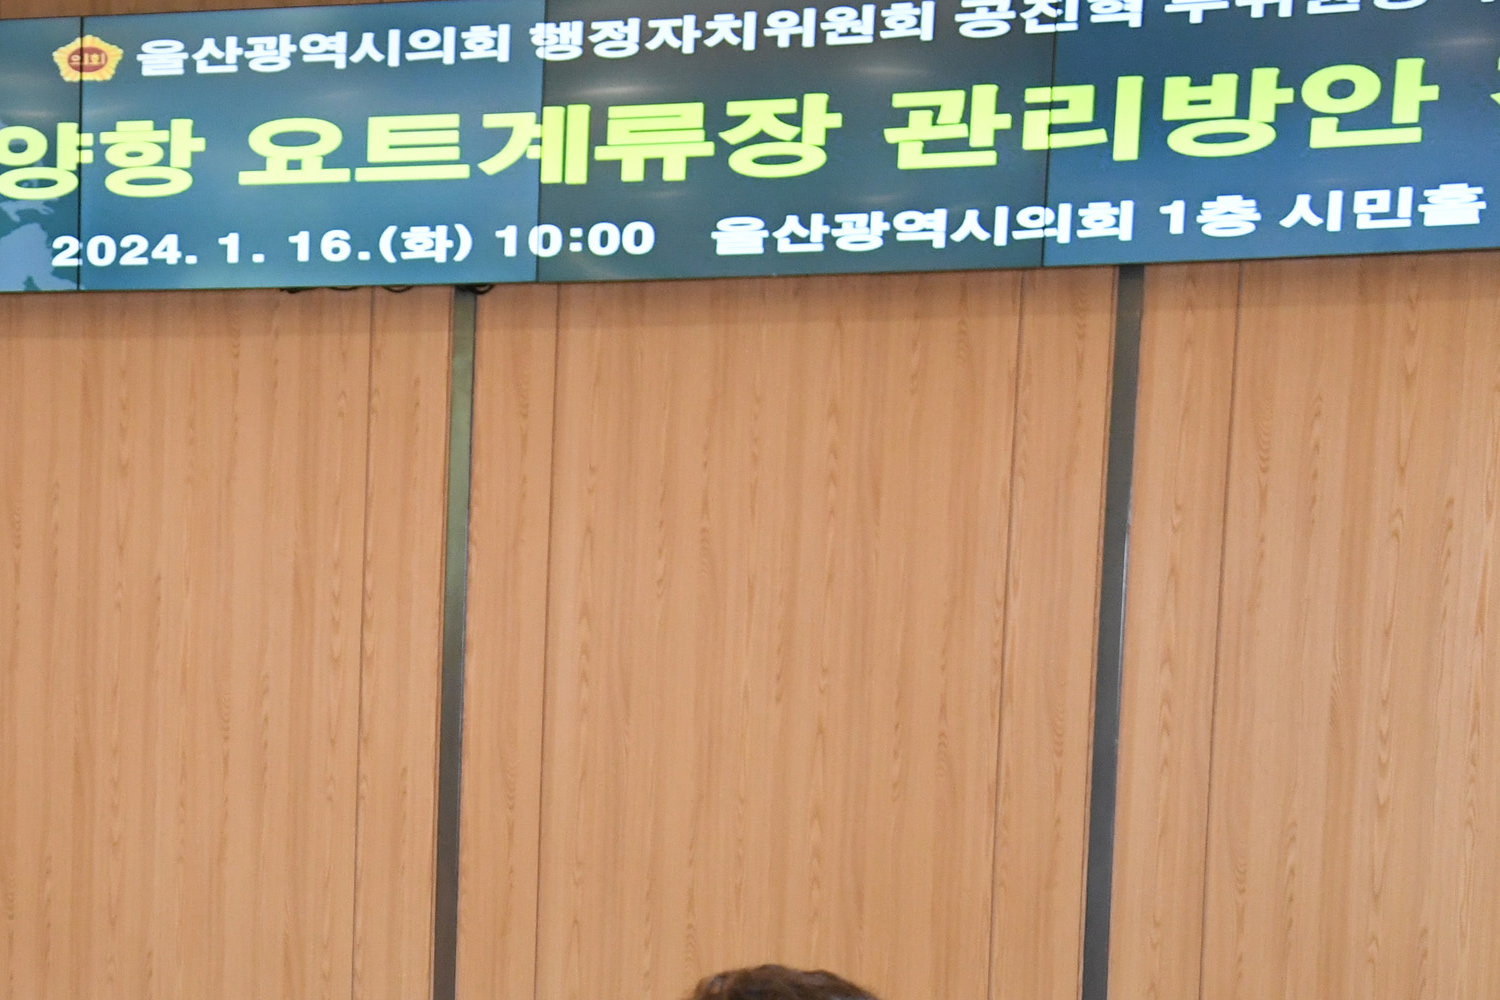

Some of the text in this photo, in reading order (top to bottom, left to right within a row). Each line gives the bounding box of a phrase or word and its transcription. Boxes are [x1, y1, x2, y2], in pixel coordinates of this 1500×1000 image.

[70, 52, 106, 66] 의회
[136, 23, 511, 77] 울산광역시의회
[529, 0, 936, 61] 행정자치위원회
[238, 93, 842, 188] 요트계류장
[884, 57, 1440, 171] 관리방안
[51, 182, 1488, 268] 2024. 1. 16.(화) 10:00 울산광역시의회 1층 시민홀
